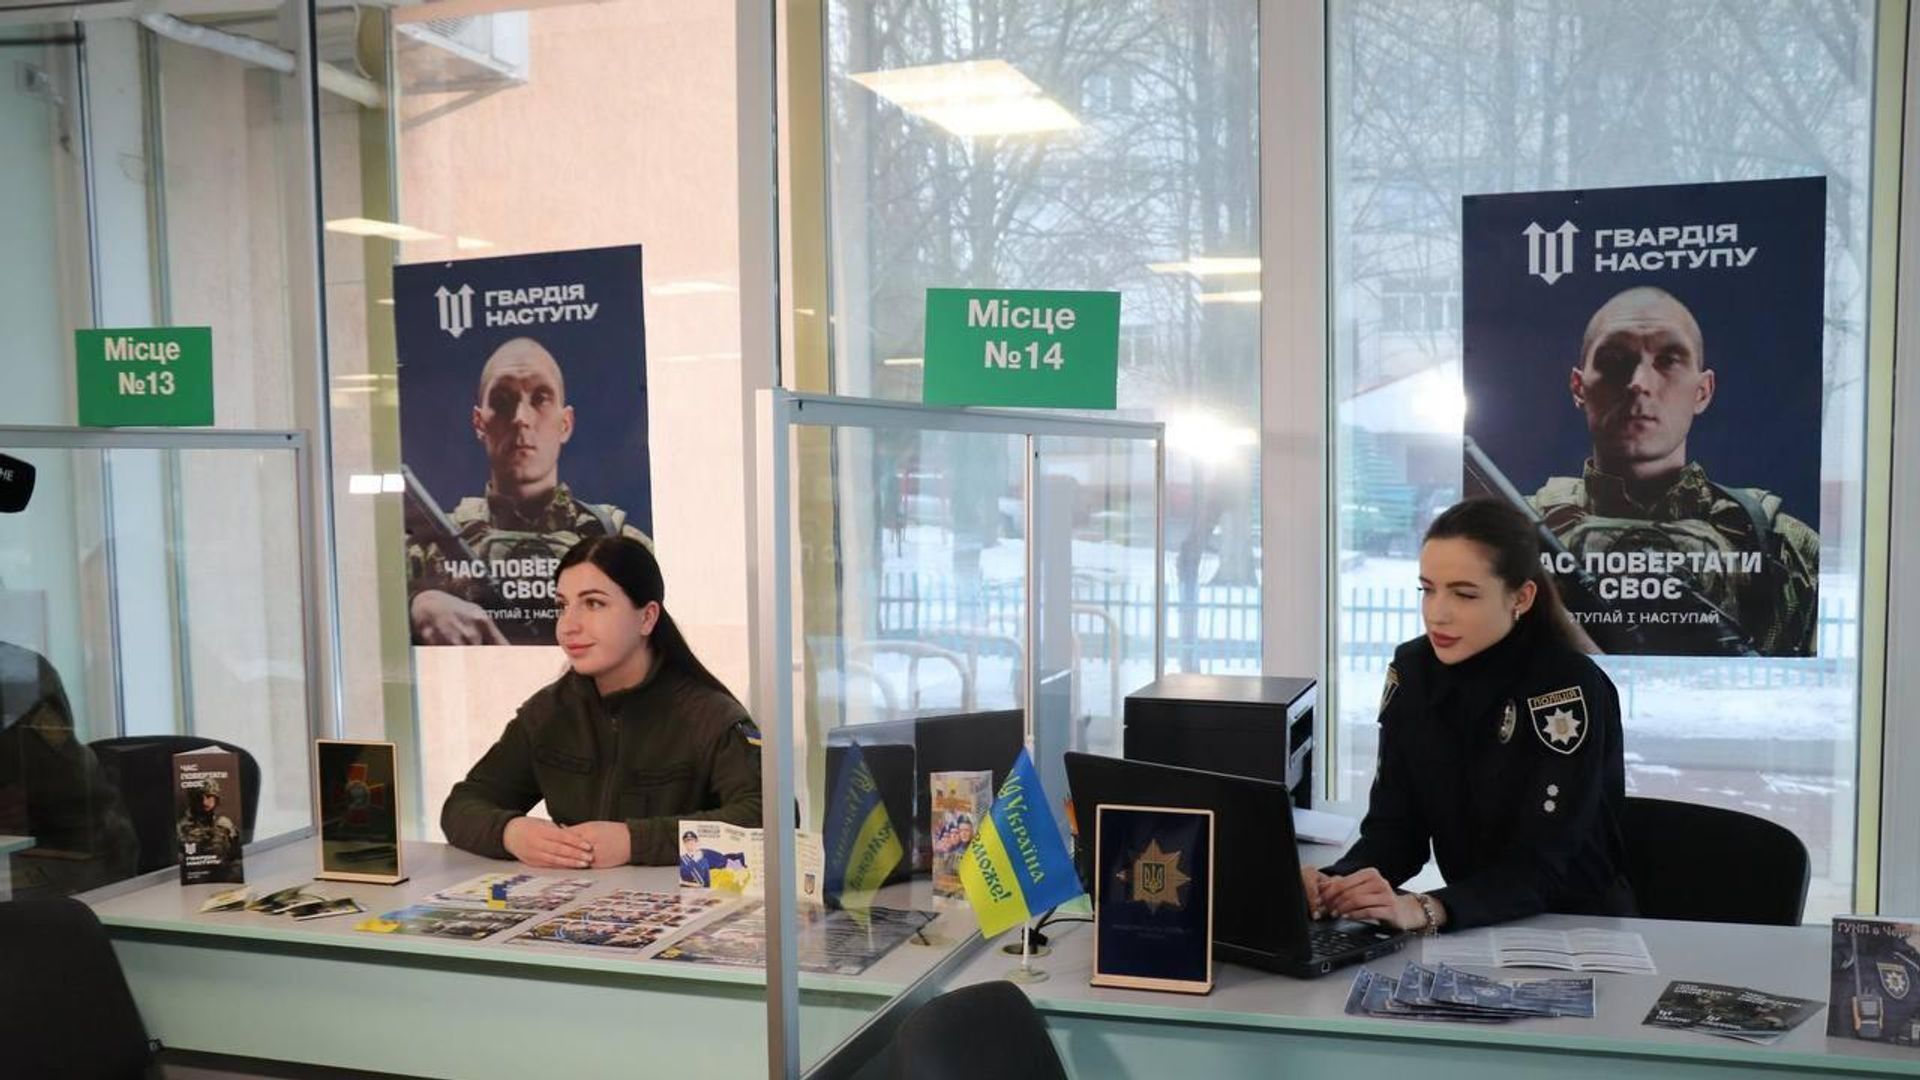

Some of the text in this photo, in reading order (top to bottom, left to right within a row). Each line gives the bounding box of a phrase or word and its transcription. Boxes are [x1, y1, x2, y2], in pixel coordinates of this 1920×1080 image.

[1595, 224, 1738, 248] ГВАРДІЯ
[1595, 247, 1758, 272] НАСТУПУ
[485, 284, 585, 307] ГВАРДІЯ
[485, 303, 599, 327] НАСТУПУ
[967, 298, 1076, 334] Місце
[104, 336, 181, 365] Місце
[984, 340, 1064, 370] №14
[118, 371, 176, 395] №13
[444, 557, 561, 579] ЧАС ПОВЕР
[1540, 551, 1762, 574] АС ПОВЕРТАТИ
[1600, 577, 1682, 600] СВОЄ
[1640, 609, 1720, 624] НАСТУПАЙ
